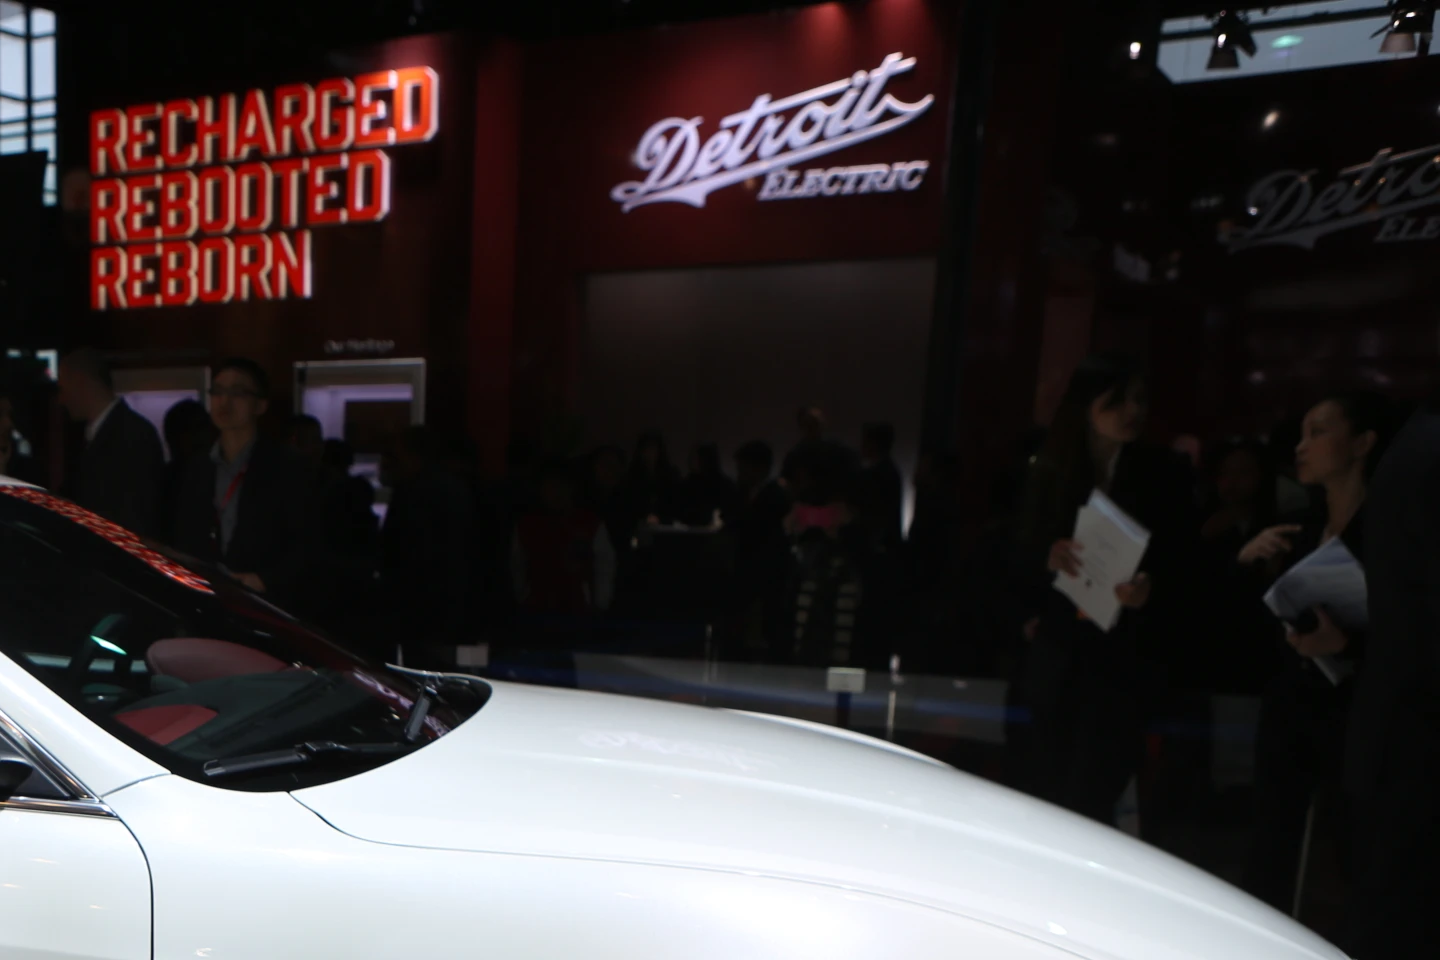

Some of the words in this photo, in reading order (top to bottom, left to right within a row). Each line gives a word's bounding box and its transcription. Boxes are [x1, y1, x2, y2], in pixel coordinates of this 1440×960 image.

[90, 66, 439, 176] RECHARGED
[611, 52, 935, 213] Detroit
[90, 148, 391, 244] REBOOTED
[758, 161, 929, 200] ELECTRIC
[90, 229, 312, 311] REBORN
